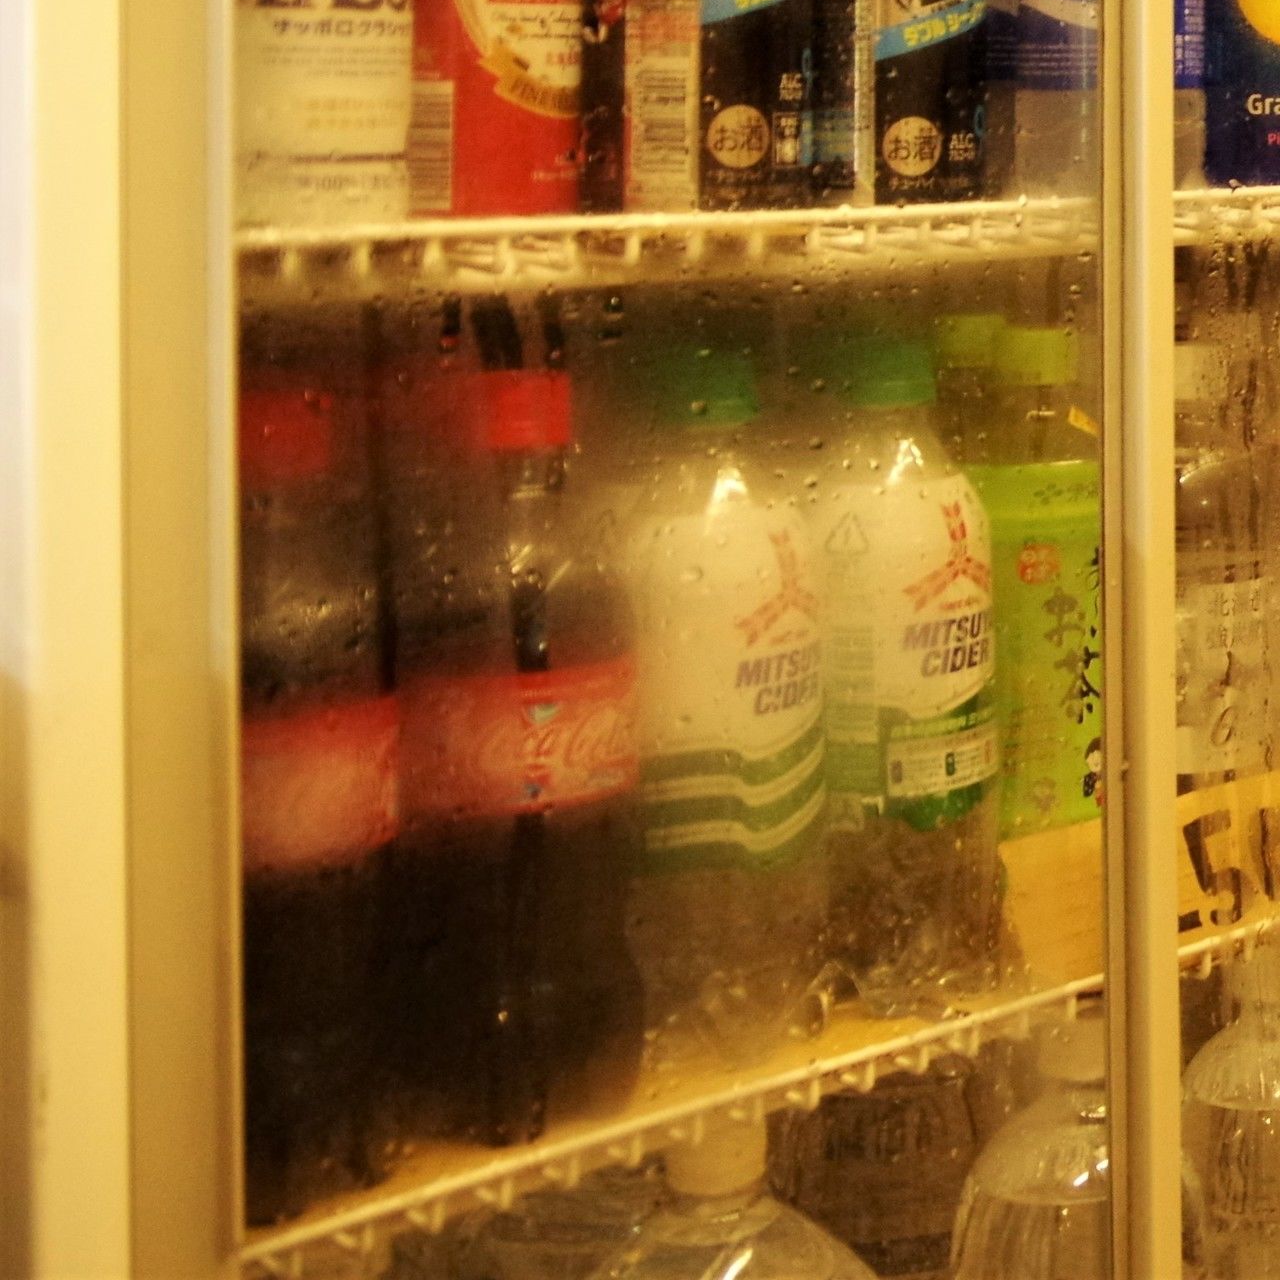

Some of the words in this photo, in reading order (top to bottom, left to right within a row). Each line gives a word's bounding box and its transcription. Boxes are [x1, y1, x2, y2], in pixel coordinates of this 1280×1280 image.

[713, 114, 766, 153] お酒
[887, 125, 937, 161] お酒
[903, 609, 990, 652] MITSU
[736, 642, 819, 690] MITSU
[921, 638, 991, 678] CIDER
